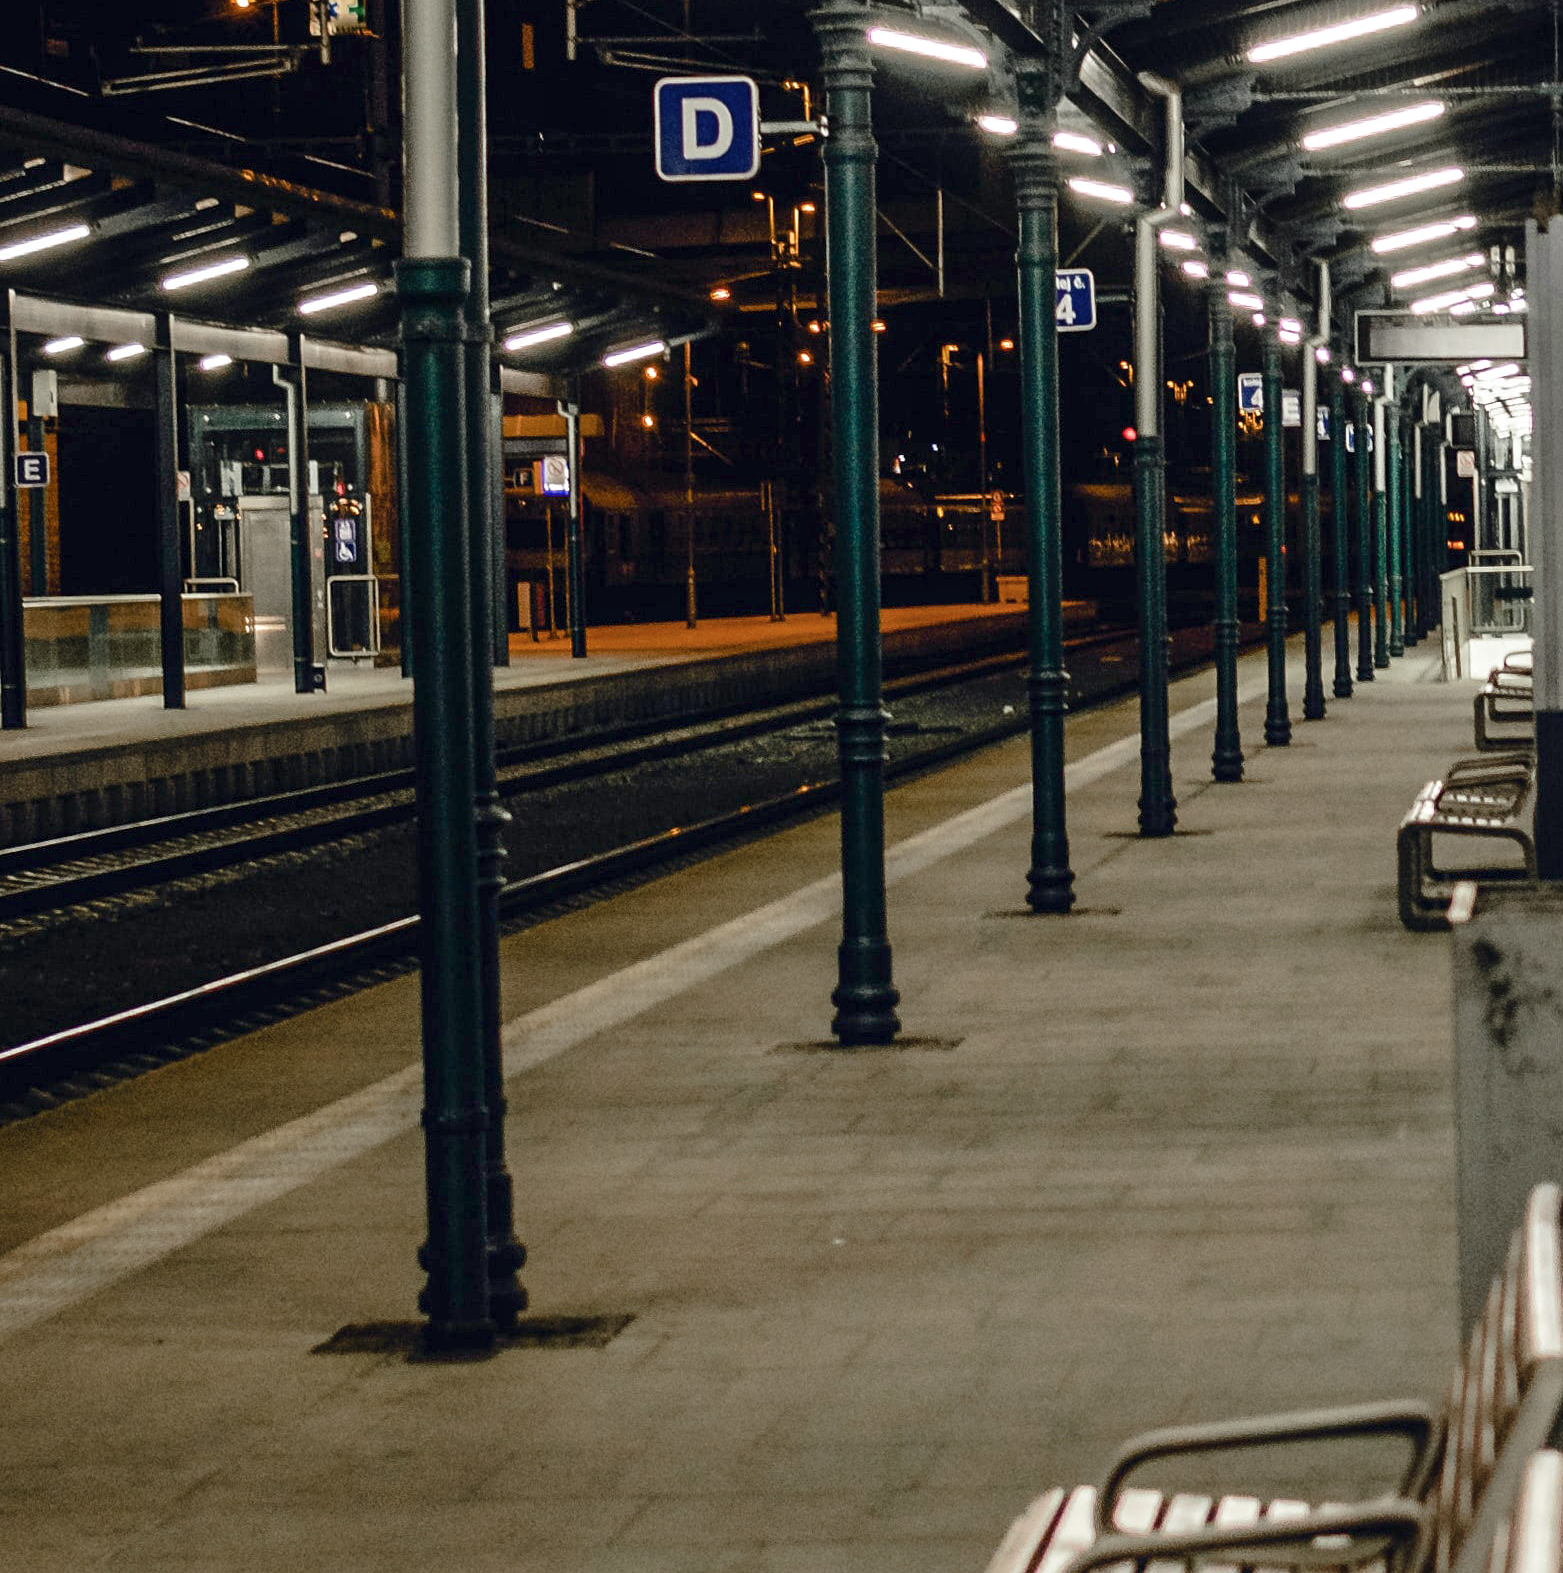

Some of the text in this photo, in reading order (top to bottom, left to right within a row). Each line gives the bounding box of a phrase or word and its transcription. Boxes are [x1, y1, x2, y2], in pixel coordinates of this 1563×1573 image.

[682, 97, 733, 160] D
[1056, 293, 1076, 325] 4
[24, 459, 41, 480] E
